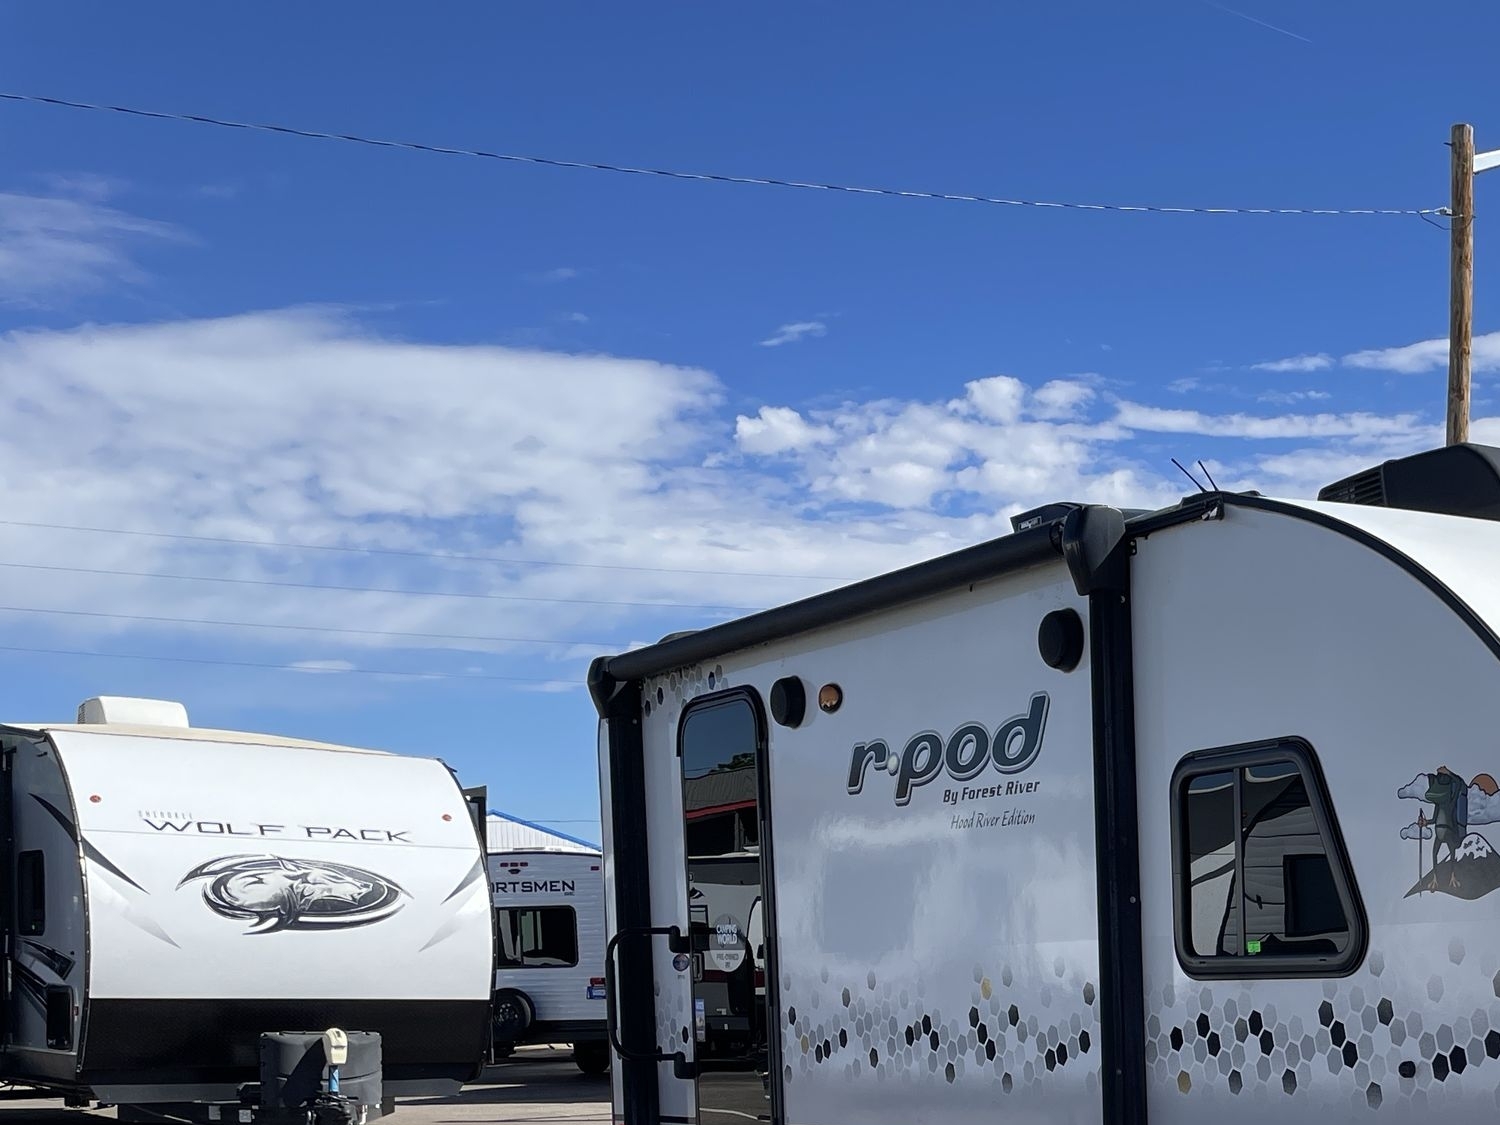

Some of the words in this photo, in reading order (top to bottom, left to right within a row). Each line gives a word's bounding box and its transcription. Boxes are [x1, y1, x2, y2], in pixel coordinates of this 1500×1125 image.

[943, 787, 958, 805] By
[961, 783, 1002, 801] Forest
[1005, 780, 1040, 796] River
[951, 810, 976, 830] Hood
[976, 811, 1000, 829] River
[1001, 808, 1036, 827] Edition
[142, 818, 285, 836] WOLF
[302, 824, 413, 843] PACK
[716, 924, 738, 934] CAMPING
[716, 934, 738, 945] WORLD
